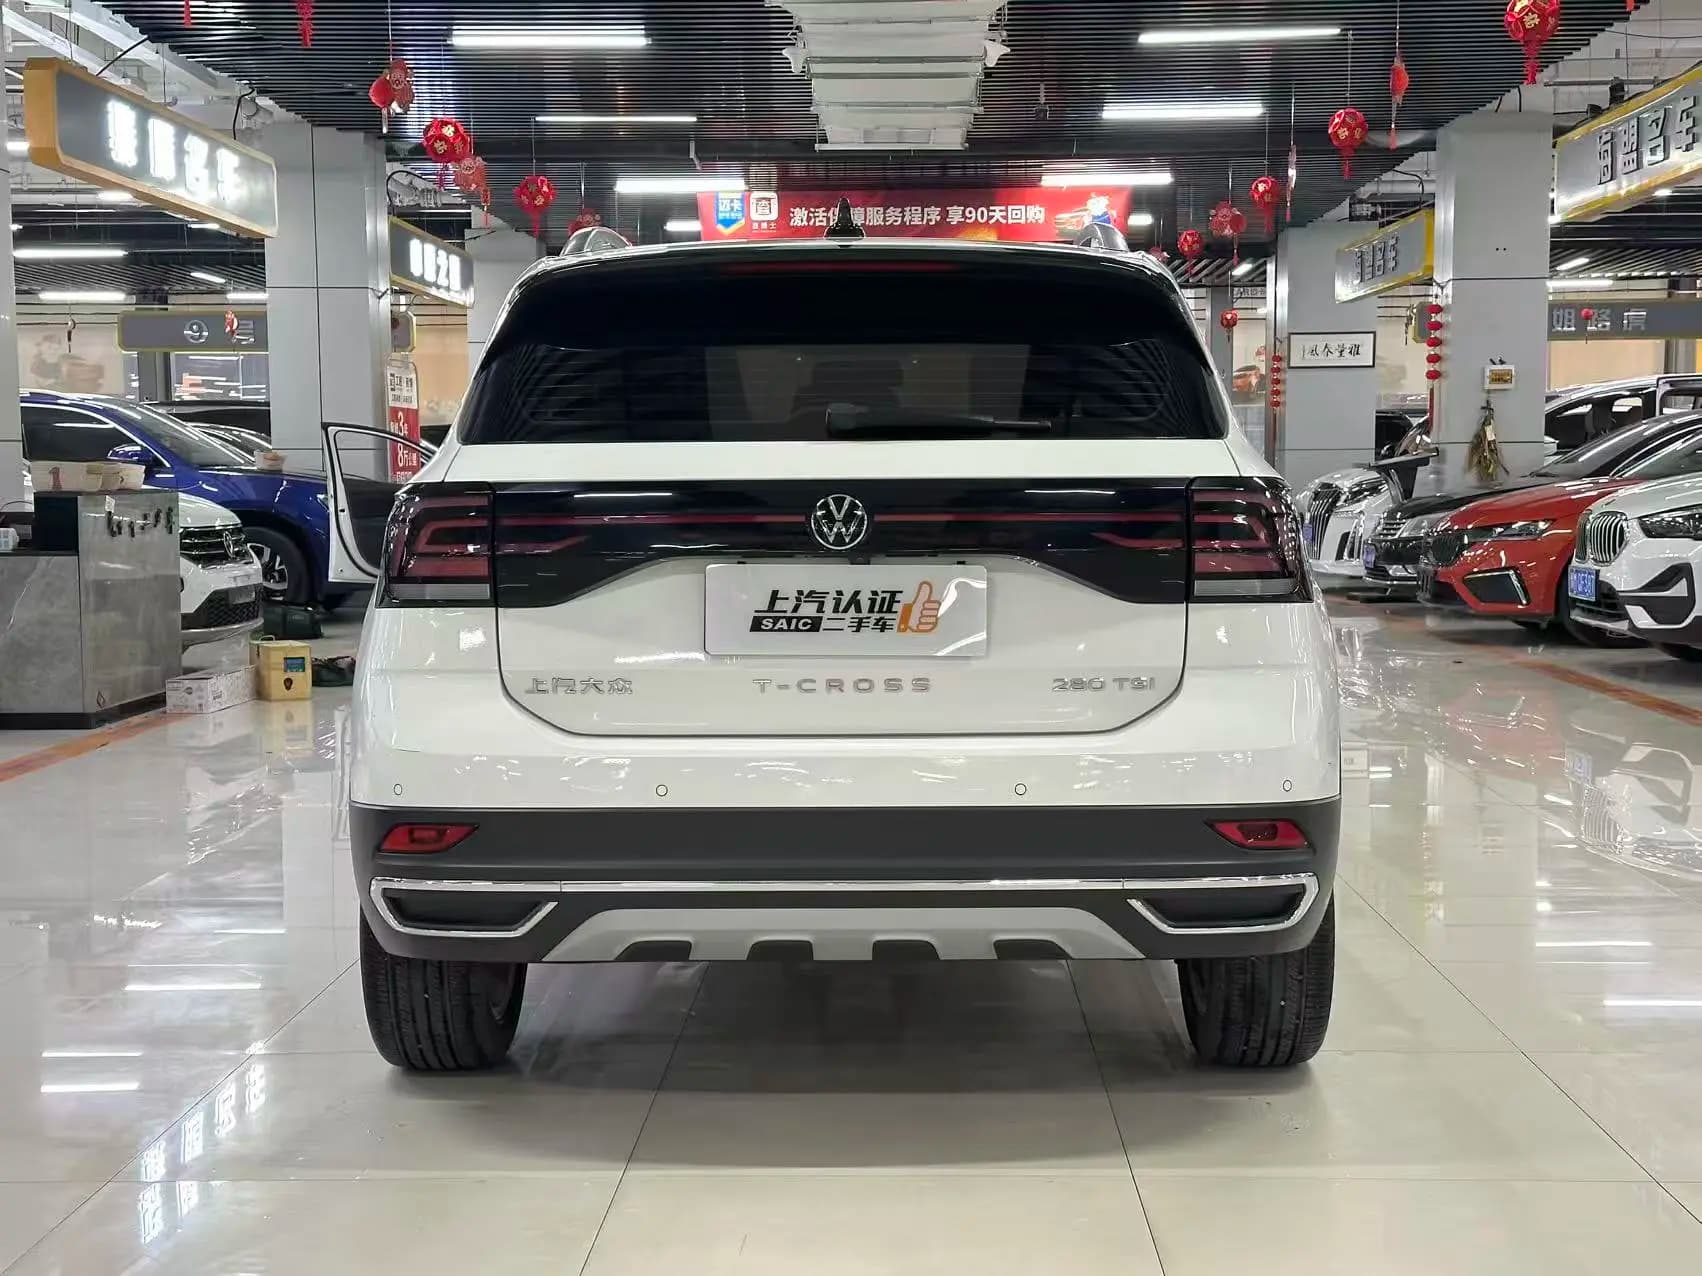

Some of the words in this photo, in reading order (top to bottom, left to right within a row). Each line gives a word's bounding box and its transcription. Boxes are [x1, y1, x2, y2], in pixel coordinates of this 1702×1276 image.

[947, 205, 1046, 225] 享90天回购
[754, 589, 904, 614] 上汽认证
[760, 617, 813, 632] SAIC
[822, 616, 897, 633] 二手车
[524, 677, 633, 694] 上汽大众
[752, 677, 931, 693] T-CROSS
[1052, 677, 1105, 692] 280
[1112, 676, 1156, 691] TSI
